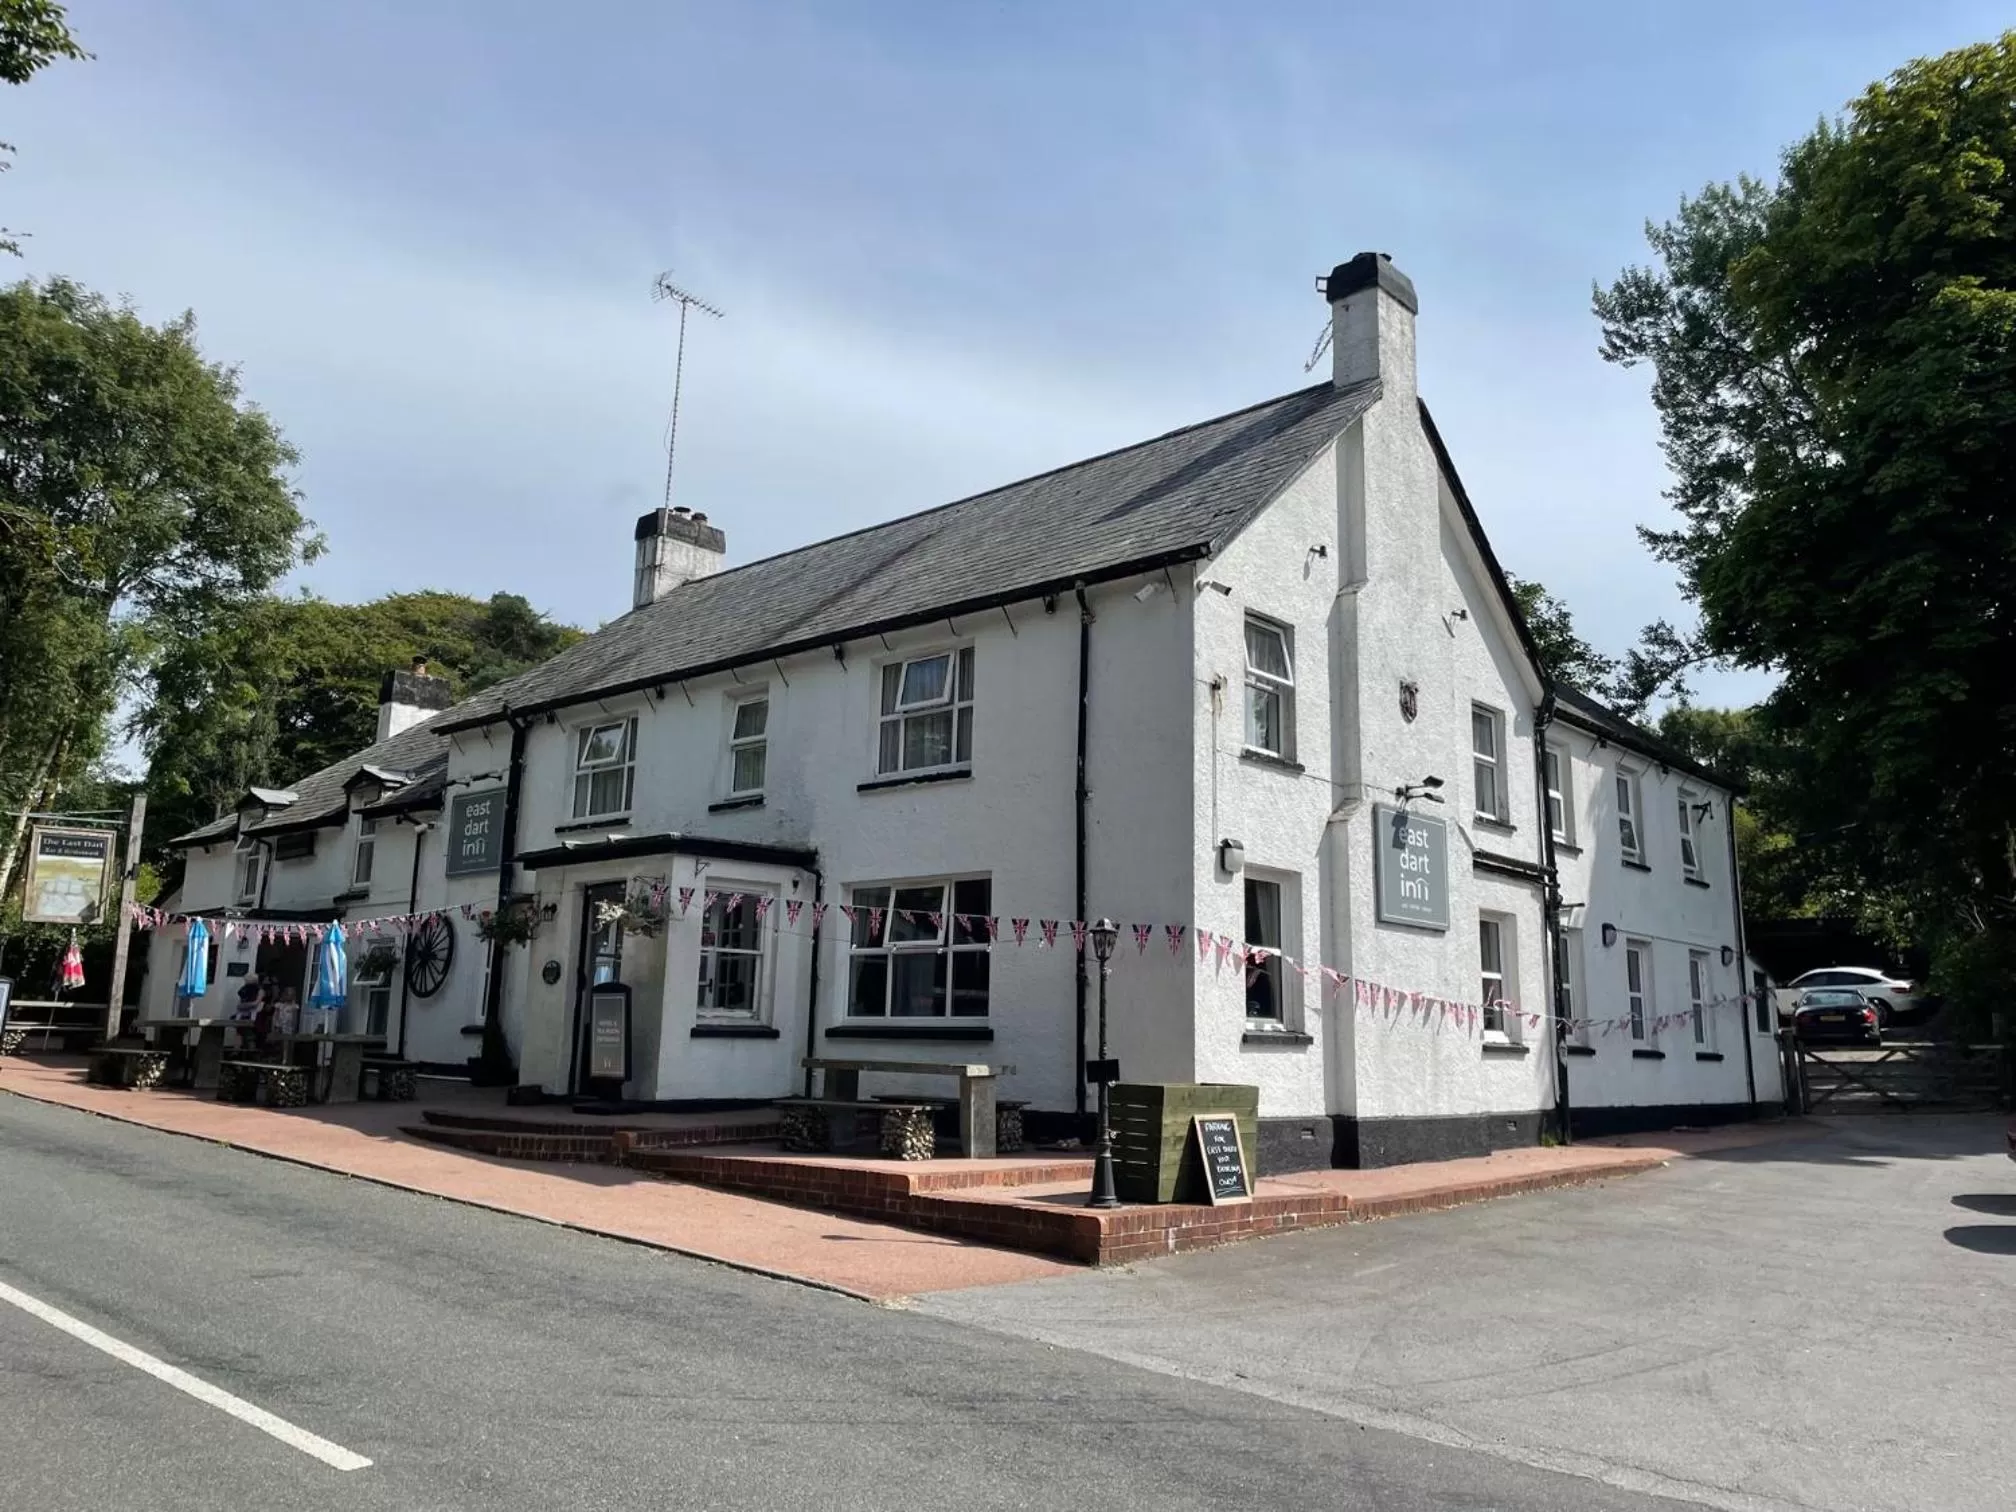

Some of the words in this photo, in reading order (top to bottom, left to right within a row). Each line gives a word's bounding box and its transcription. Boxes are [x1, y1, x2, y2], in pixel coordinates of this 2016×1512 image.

[466, 800, 491, 817] east
[464, 819, 489, 836] dart
[462, 837, 486, 857] inn
[1399, 828, 1429, 849] east
[1399, 847, 1430, 874] dart
[1400, 873, 1430, 901] inn
